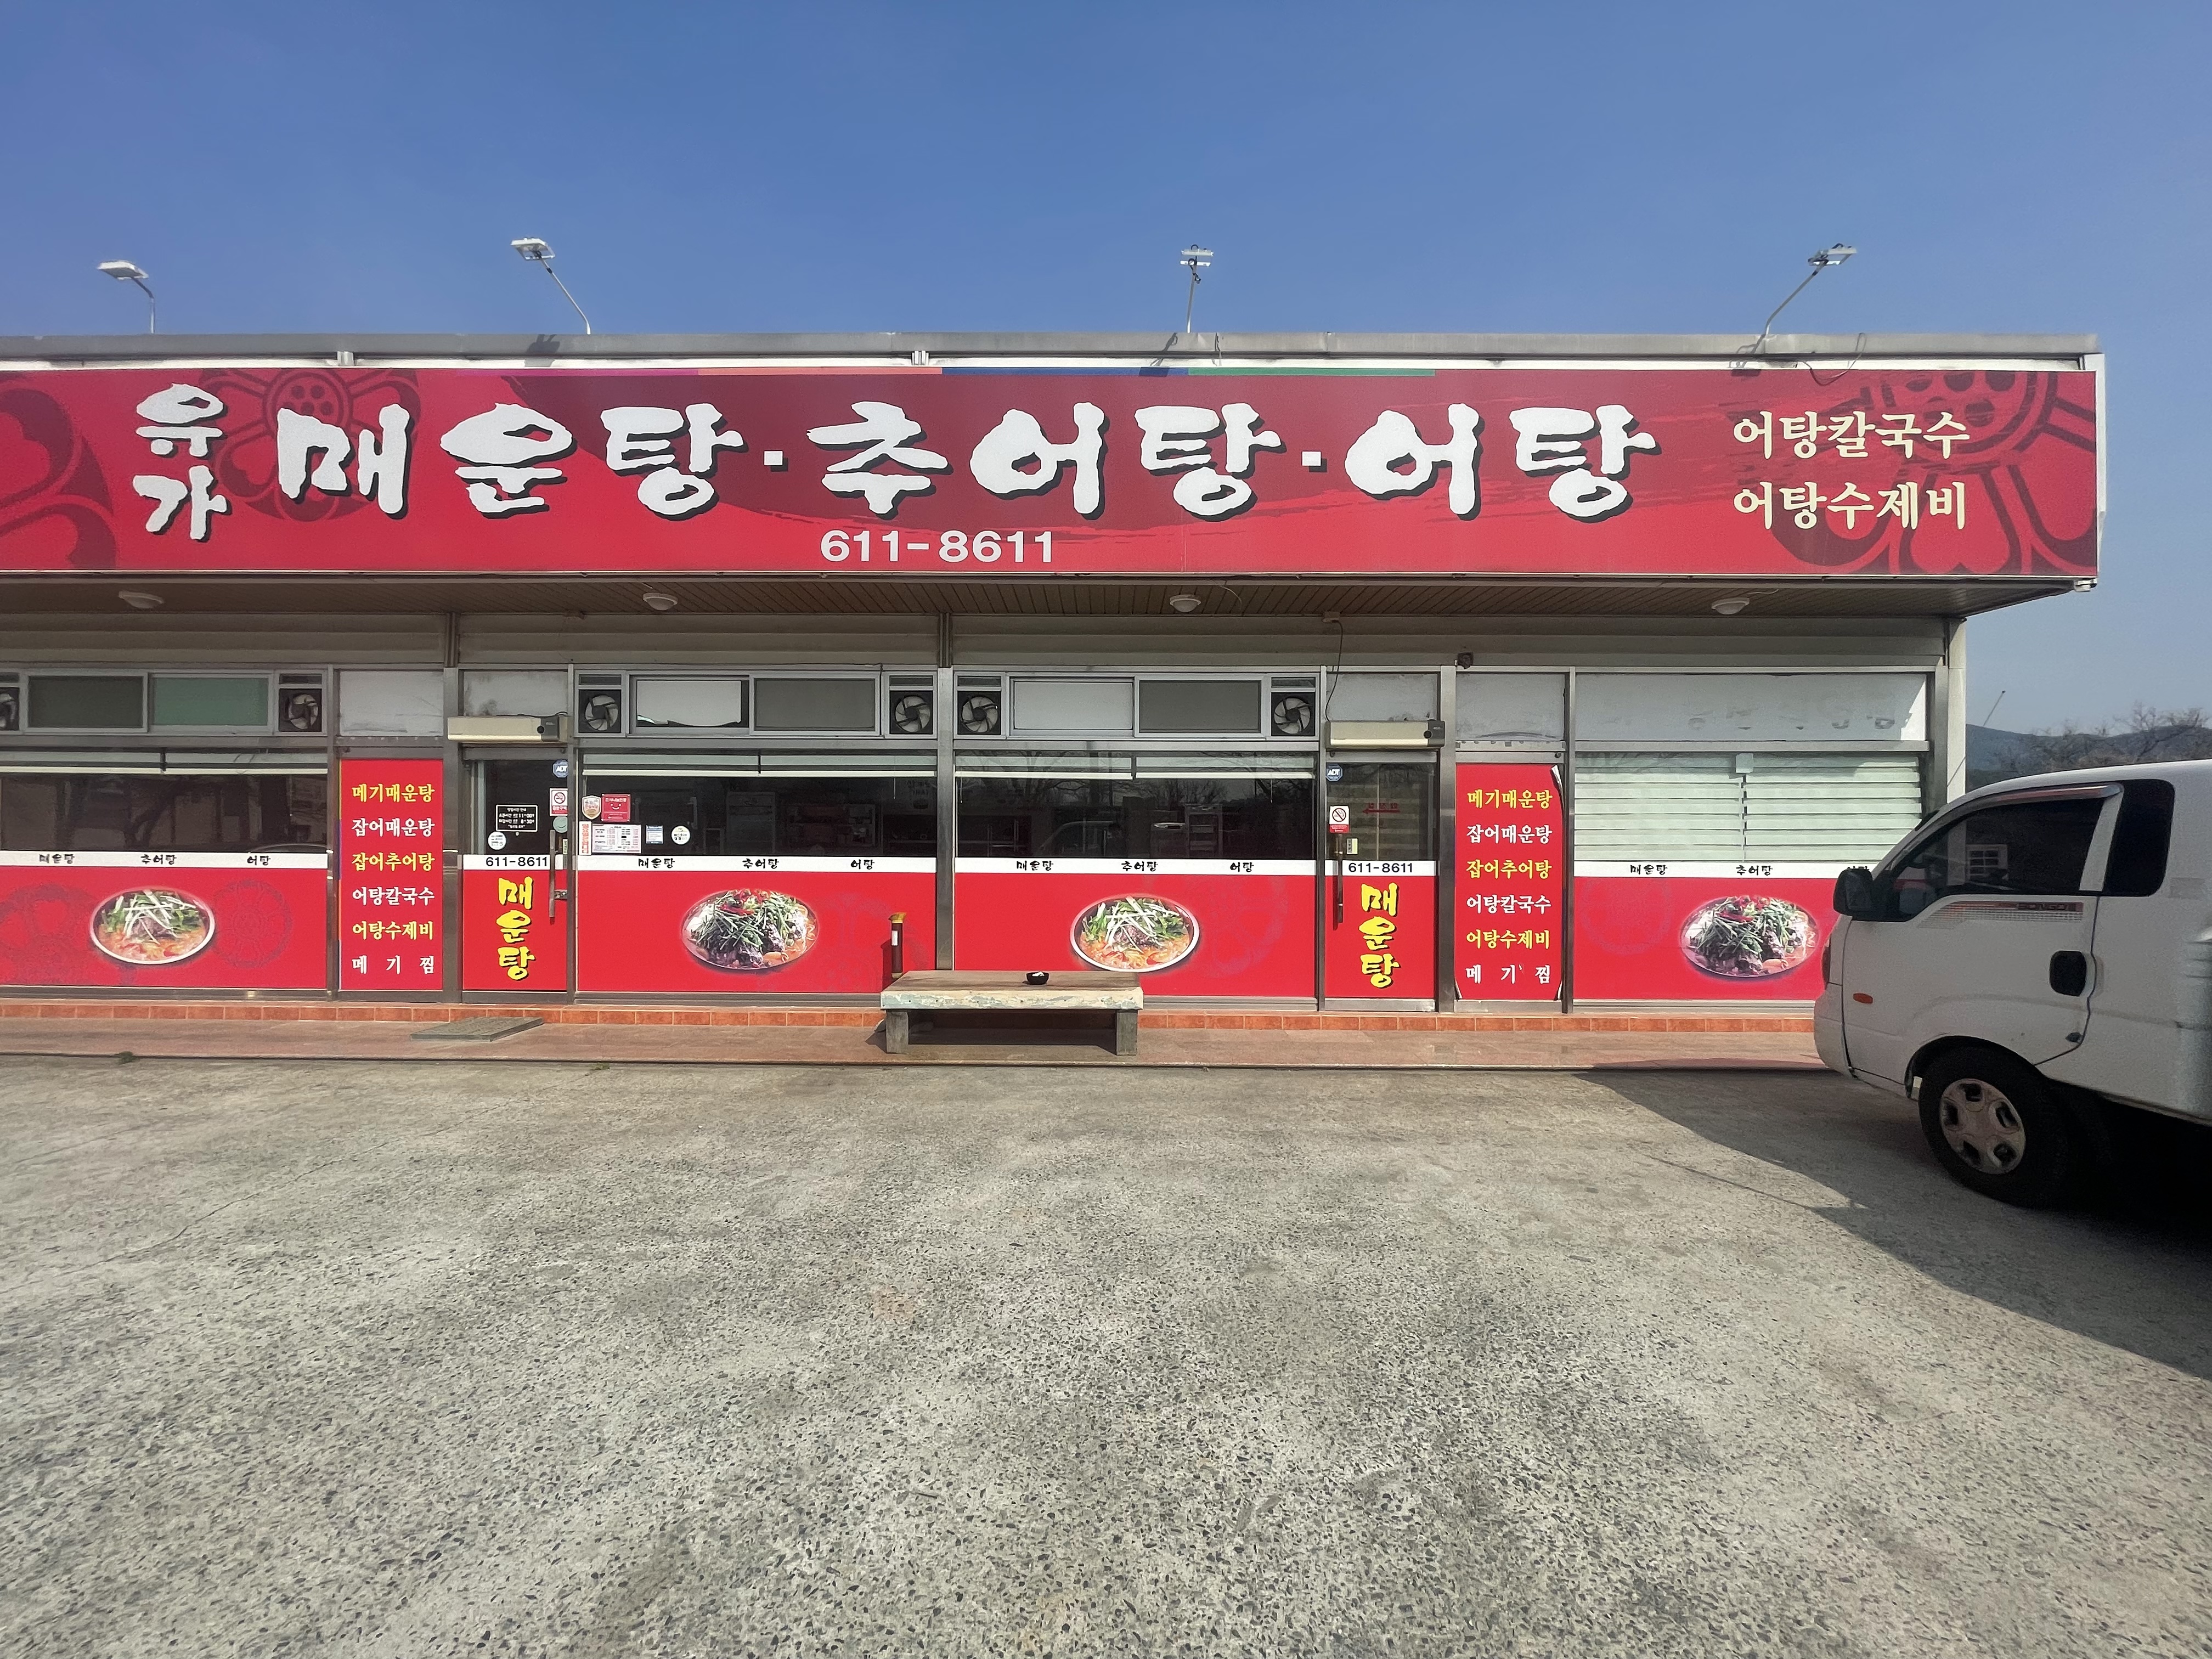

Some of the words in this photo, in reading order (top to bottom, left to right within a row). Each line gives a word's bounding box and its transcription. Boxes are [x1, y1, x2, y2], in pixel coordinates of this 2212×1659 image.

[1733, 410, 1970, 459] 어탕칼국수
[133, 383, 227, 540] 유가
[1734, 481, 1965, 530] 어탕수제비
[821, 530, 1052, 563] 611-8611
[352, 783, 435, 803] 메기매운탕
[1467, 789, 1553, 809] 메기매운탕
[351, 817, 436, 837] 잡어매운탕
[1466, 824, 1553, 844] 잡어매운탕
[40, 854, 75, 864] 매운탕
[141, 854, 177, 865] 추어탕
[247, 855, 272, 866] 어탕
[351, 852, 436, 872] 잡어추어탕
[486, 856, 548, 867] 611-8611
[637, 857, 675, 868] 매운탕
[742, 858, 779, 870] 추어탕
[850, 859, 875, 870] 어탕
[1016, 860, 1054, 871] 매운탕
[1121, 861, 1158, 872] 추어탕
[1229, 862, 1254, 873] 어탕
[1348, 862, 1413, 873] 611-8611
[1466, 859, 1553, 879] 잡어추어탕
[1629, 864, 1668, 876] 매운탕
[1736, 865, 1773, 876] 추어탕
[352, 886, 435, 906] 어탕칼국수
[1466, 894, 1551, 915] 어탕칼국수
[352, 921, 433, 940] 어탕수제비
[496, 876, 535, 980] 매운탕
[1358, 882, 1400, 988] 매운탕
[1466, 929, 1550, 950] 어탕수제비
